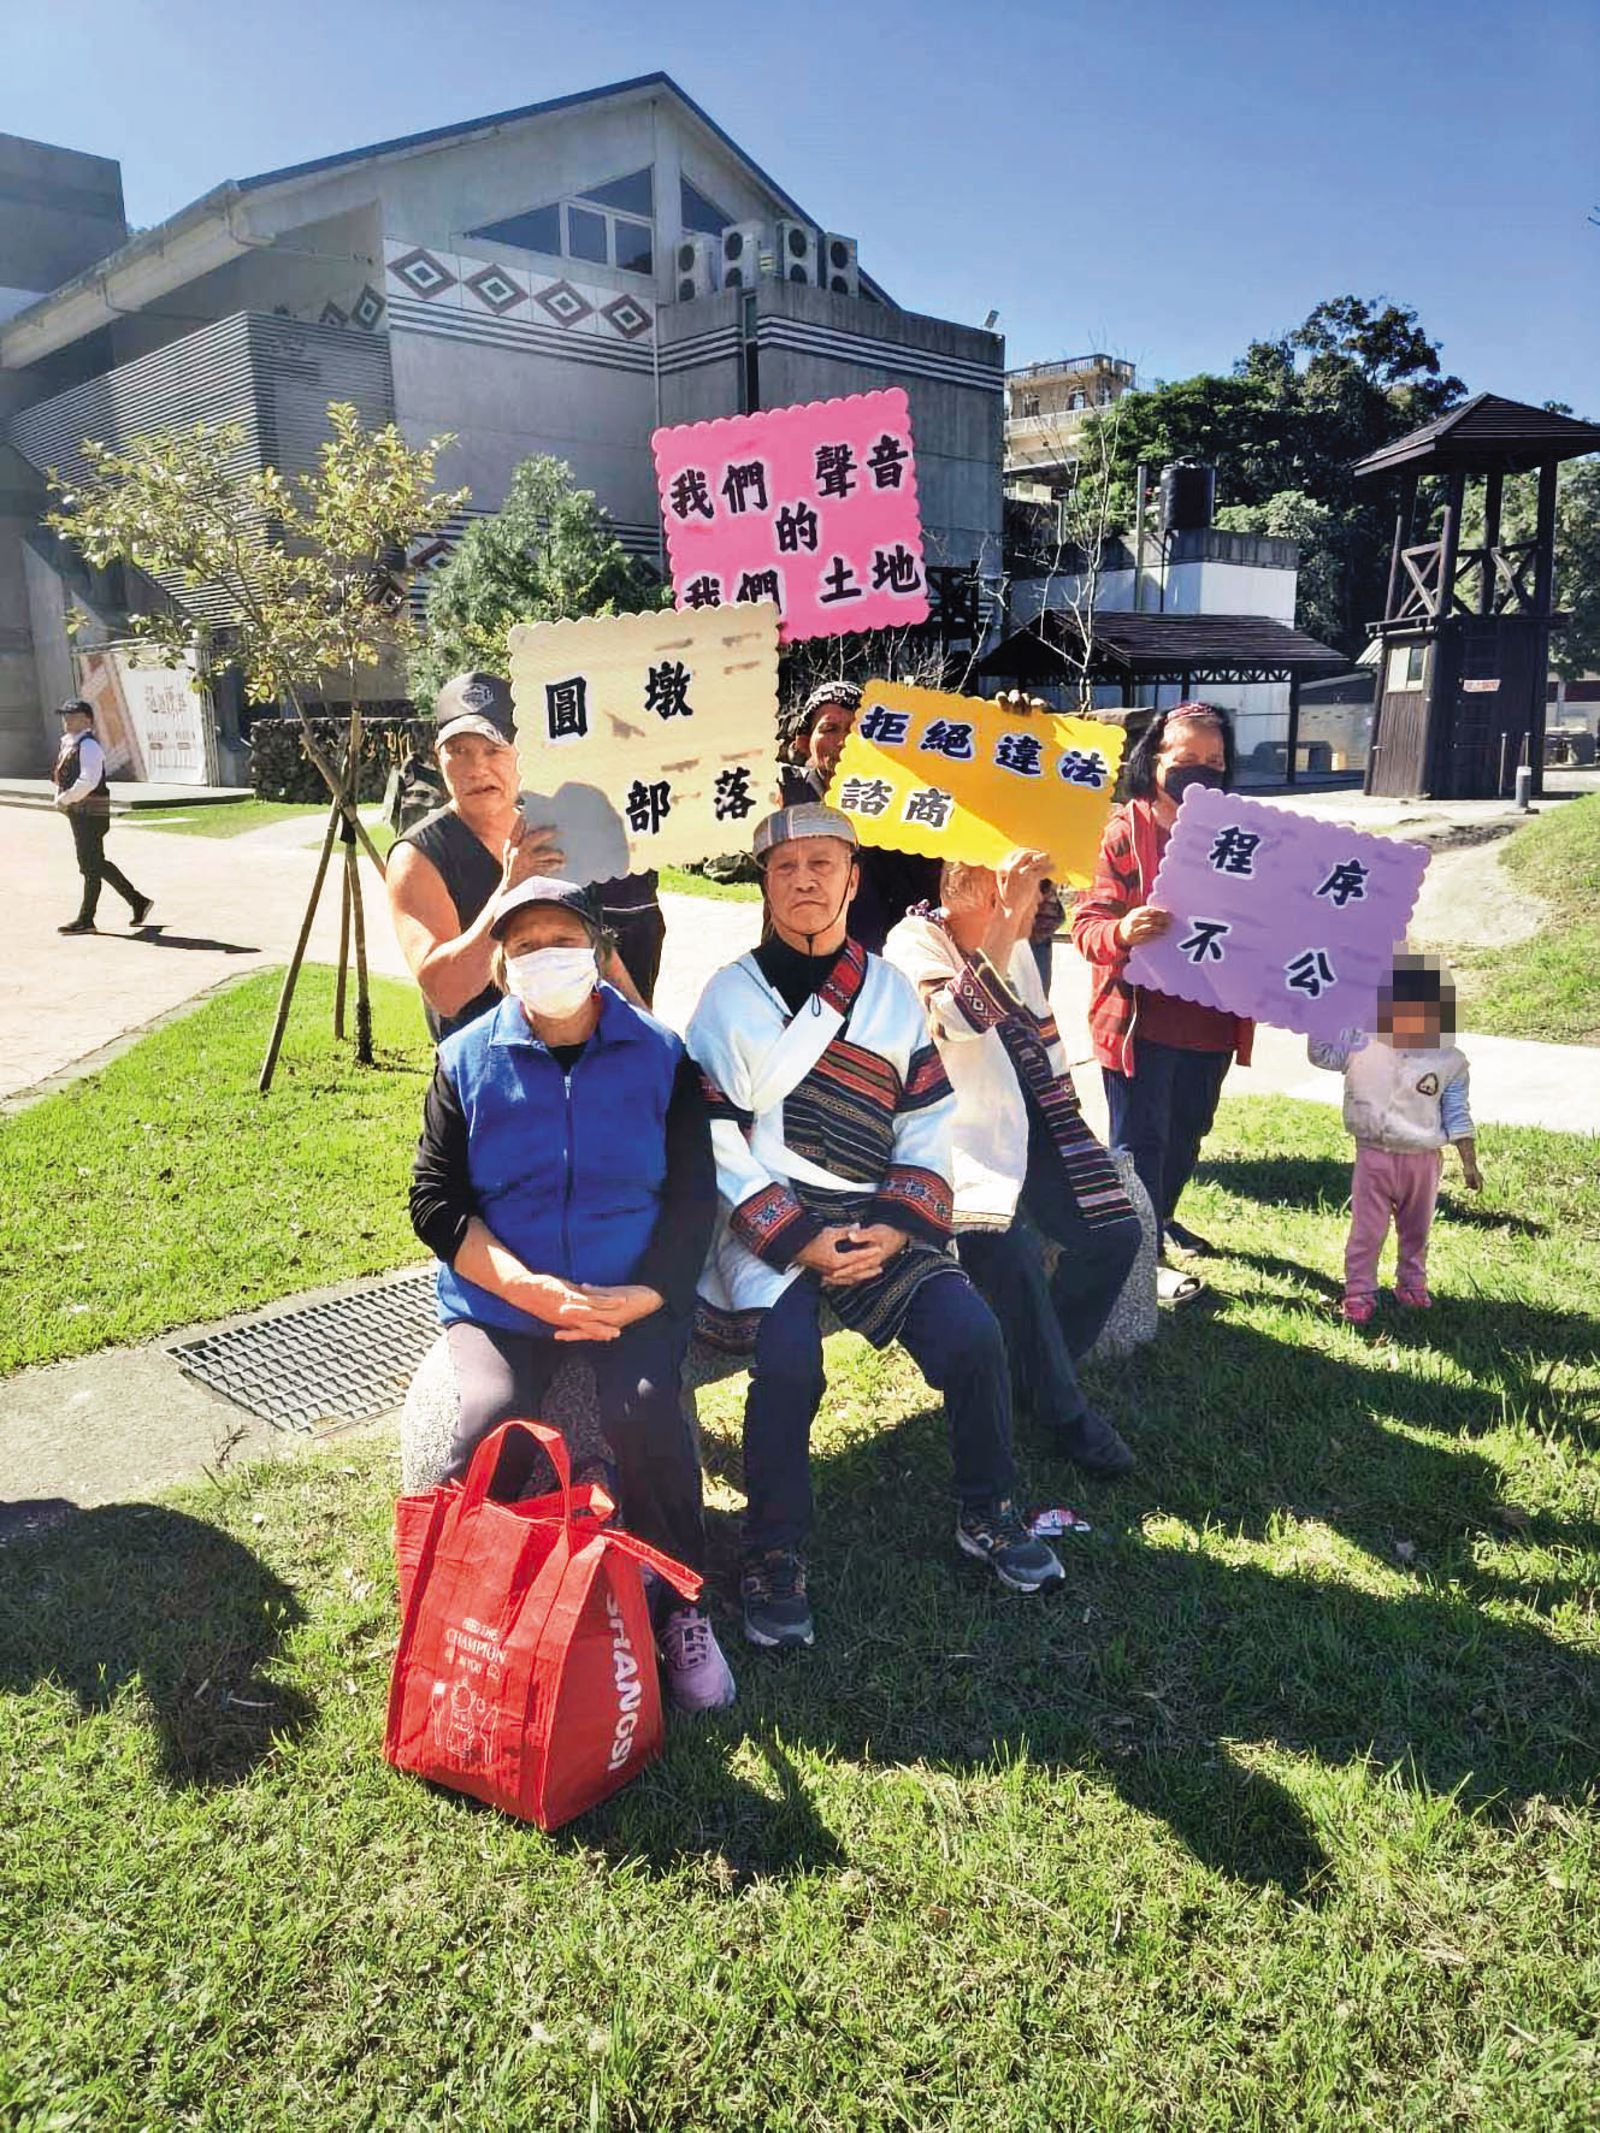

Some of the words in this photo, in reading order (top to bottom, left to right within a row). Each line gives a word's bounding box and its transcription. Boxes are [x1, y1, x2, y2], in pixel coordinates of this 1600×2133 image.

[671, 461, 768, 519] 我們
[814, 434, 909, 498] 聲音
[775, 501, 818, 552] 的
[820, 545, 921, 602] 土地
[545, 660, 694, 739] 圓墩
[860, 706, 1107, 788] 拒絕違法
[625, 766, 757, 834] 部落
[841, 778, 951, 828] 諮商
[1210, 826, 1369, 905] 程序
[1178, 922, 1335, 997] 不公
